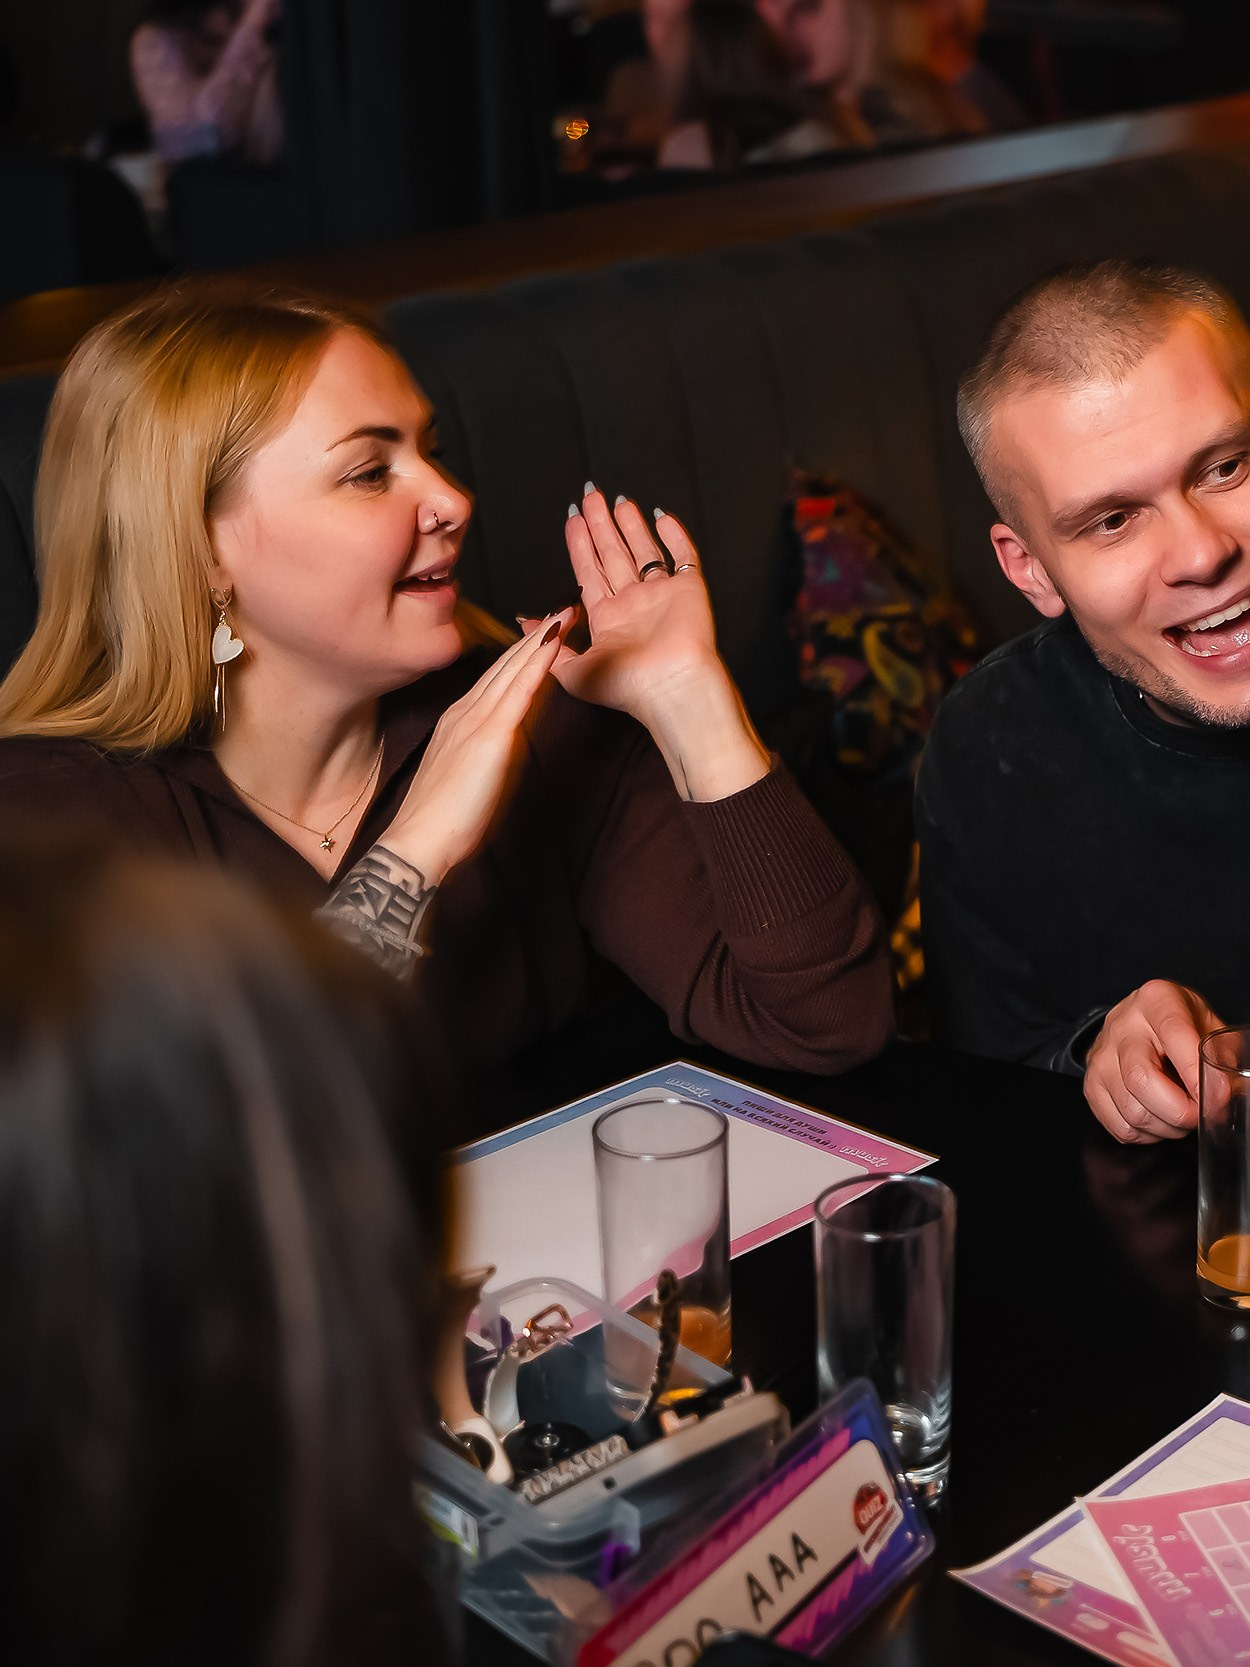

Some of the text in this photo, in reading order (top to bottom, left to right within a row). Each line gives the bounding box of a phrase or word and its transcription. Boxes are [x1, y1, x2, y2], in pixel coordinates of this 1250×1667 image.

[711, 1098, 734, 1110] ИЛИ
[732, 1106, 748, 1116] НА
[747, 1111, 789, 1130] ВСЯКИЙ
[741, 1100, 828, 1135] ПИШИ ДЛЯ ДУШИ
